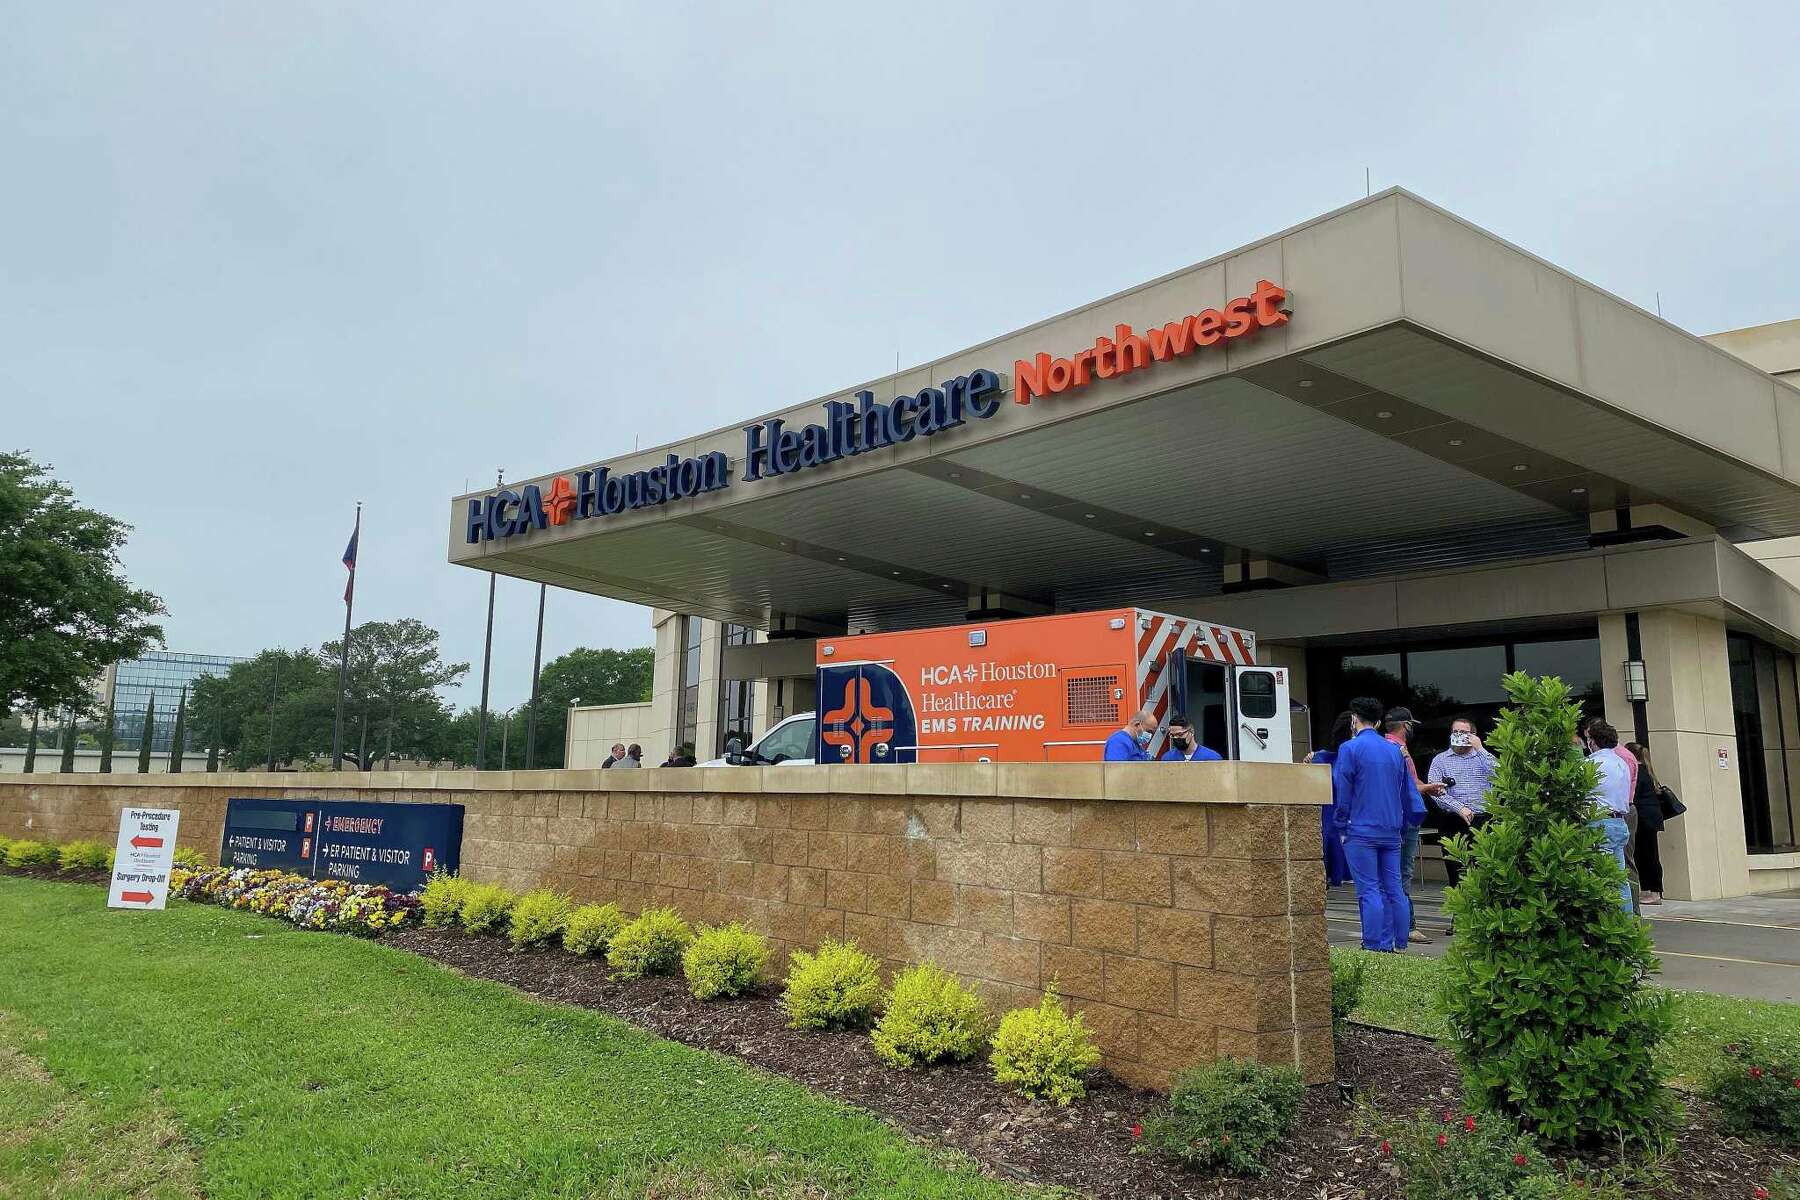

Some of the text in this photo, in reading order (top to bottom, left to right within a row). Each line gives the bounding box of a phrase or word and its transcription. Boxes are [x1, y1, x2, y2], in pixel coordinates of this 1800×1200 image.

[466, 279, 1289, 544] HCA Houston Healthcare Northwest
[921, 660, 1057, 685] HCA Houston
[921, 714, 1045, 734] EMS TRAINING
[333, 816, 384, 835] EMERGENCY
[235, 836, 257, 848] PATIENT
[263, 838, 287, 852] VISITOR
[232, 851, 258, 866] PARKING
[330, 844, 410, 865] ER PATIENT & VISITOR
[117, 872, 141, 882] Surgery
[328, 862, 360, 879] PARKING
